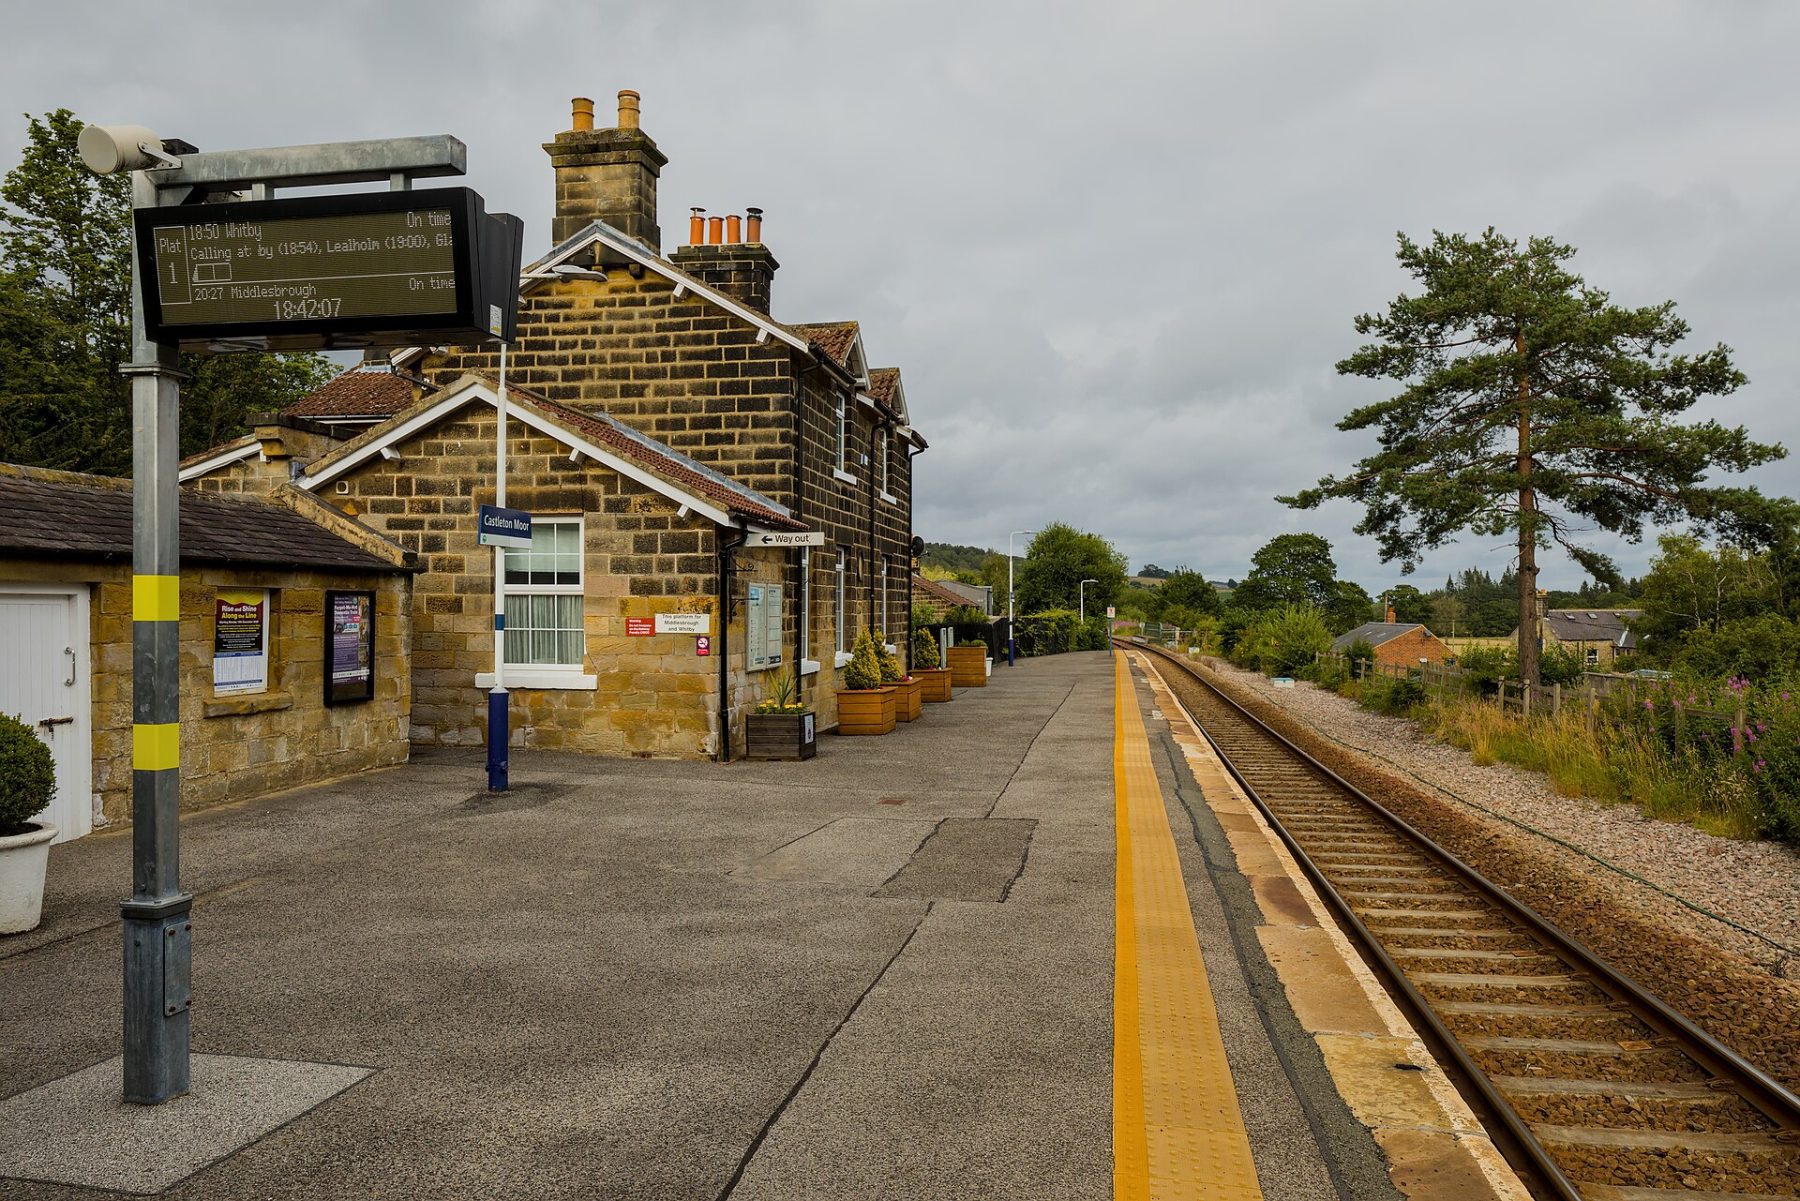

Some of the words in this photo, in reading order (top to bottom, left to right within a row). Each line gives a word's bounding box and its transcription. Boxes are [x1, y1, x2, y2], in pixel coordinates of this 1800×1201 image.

[406, 211, 422, 228] On
[427, 211, 452, 227] time
[190, 223, 220, 241] 18:50
[225, 222, 262, 241] Whitby
[159, 238, 182, 254] Plat
[190, 247, 232, 262] Calling
[278, 240, 322, 255] (18:54),
[326, 238, 380, 253] Lealholm
[168, 261, 178, 284] 1
[194, 287, 224, 301] 20:27
[231, 283, 317, 299] Middlesbrough
[408, 278, 424, 291] On
[429, 276, 455, 290] time
[273, 298, 342, 320] 18:42:07
[484, 514, 513, 529] Castleton
[513, 518, 530, 532] Moor
[775, 534, 793, 544] Way
[794, 534, 809, 543] out
[221, 612, 238, 620] Along
